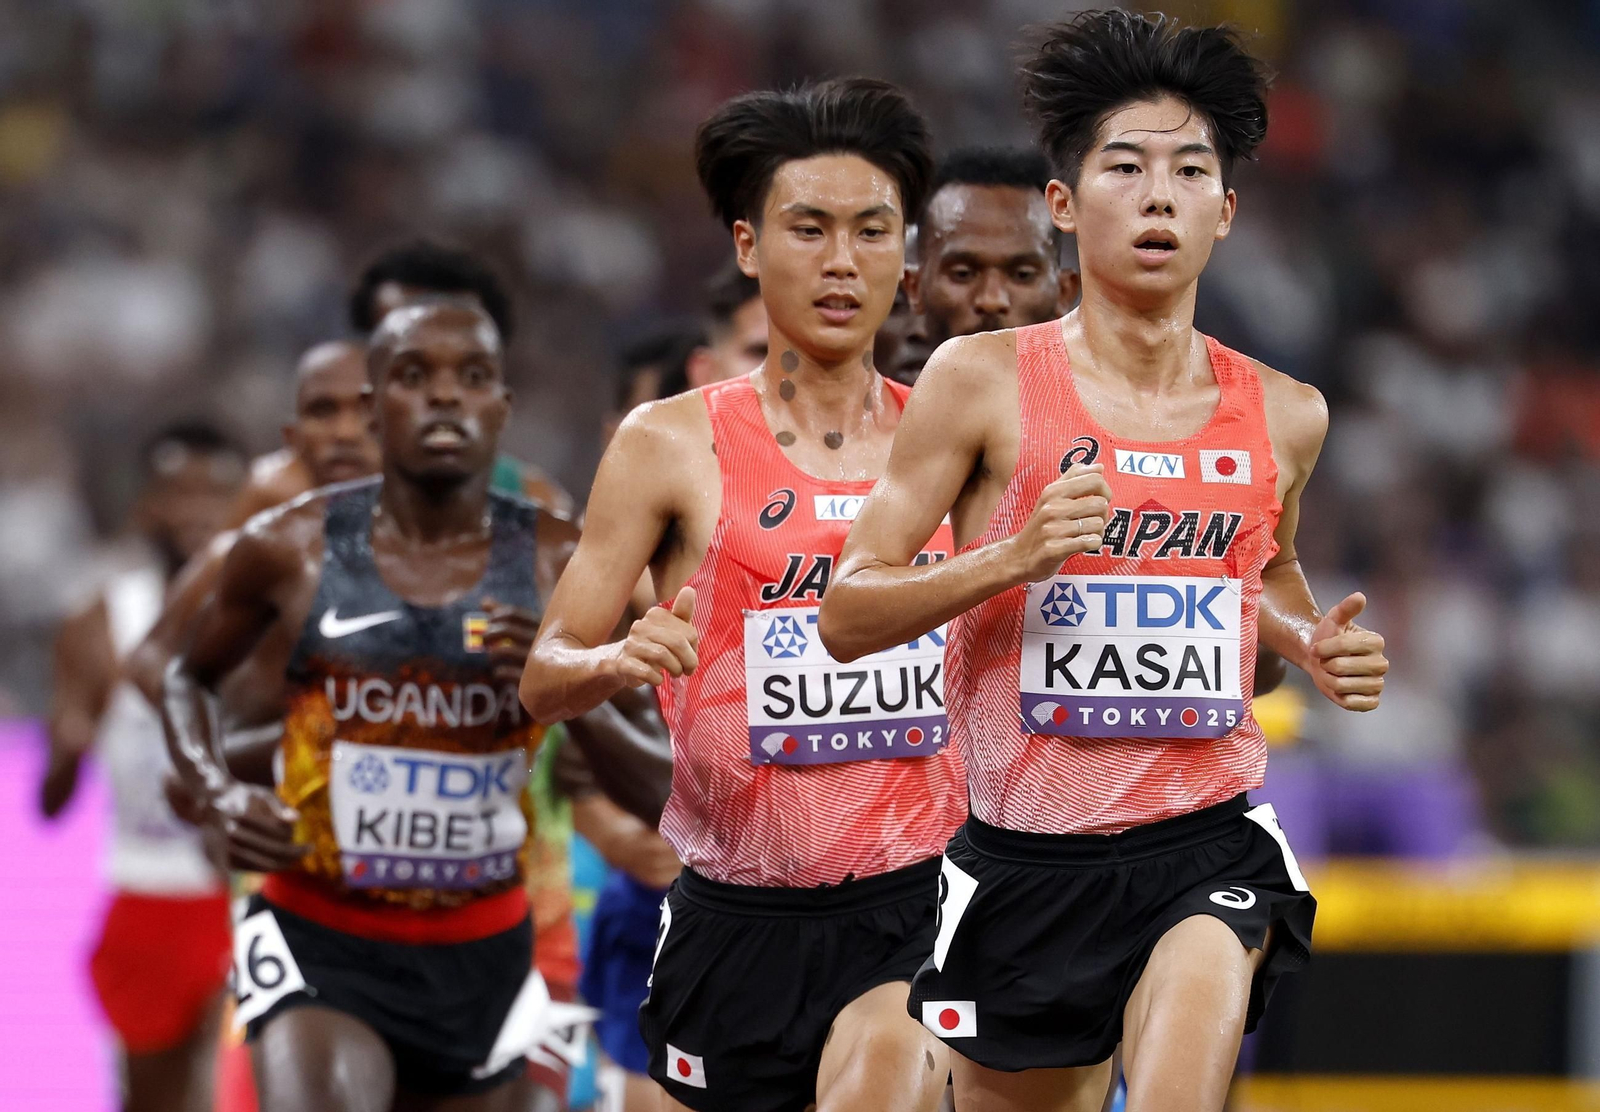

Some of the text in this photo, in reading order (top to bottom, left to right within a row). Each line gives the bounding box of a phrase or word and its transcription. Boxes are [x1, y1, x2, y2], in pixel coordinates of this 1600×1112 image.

[1120, 453, 1180, 476] ACN
[820, 498, 866, 518] AC
[1083, 508, 1242, 560] APAN
[1086, 583, 1226, 630] TDK
[1045, 642, 1222, 691] KASAI
[325, 675, 521, 728] UGANDA
[762, 663, 944, 720] SUZUK
[932, 724, 950, 744] 2
[393, 757, 513, 799] TDK
[355, 807, 497, 851] KIBET
[234, 932, 286, 989] 6
